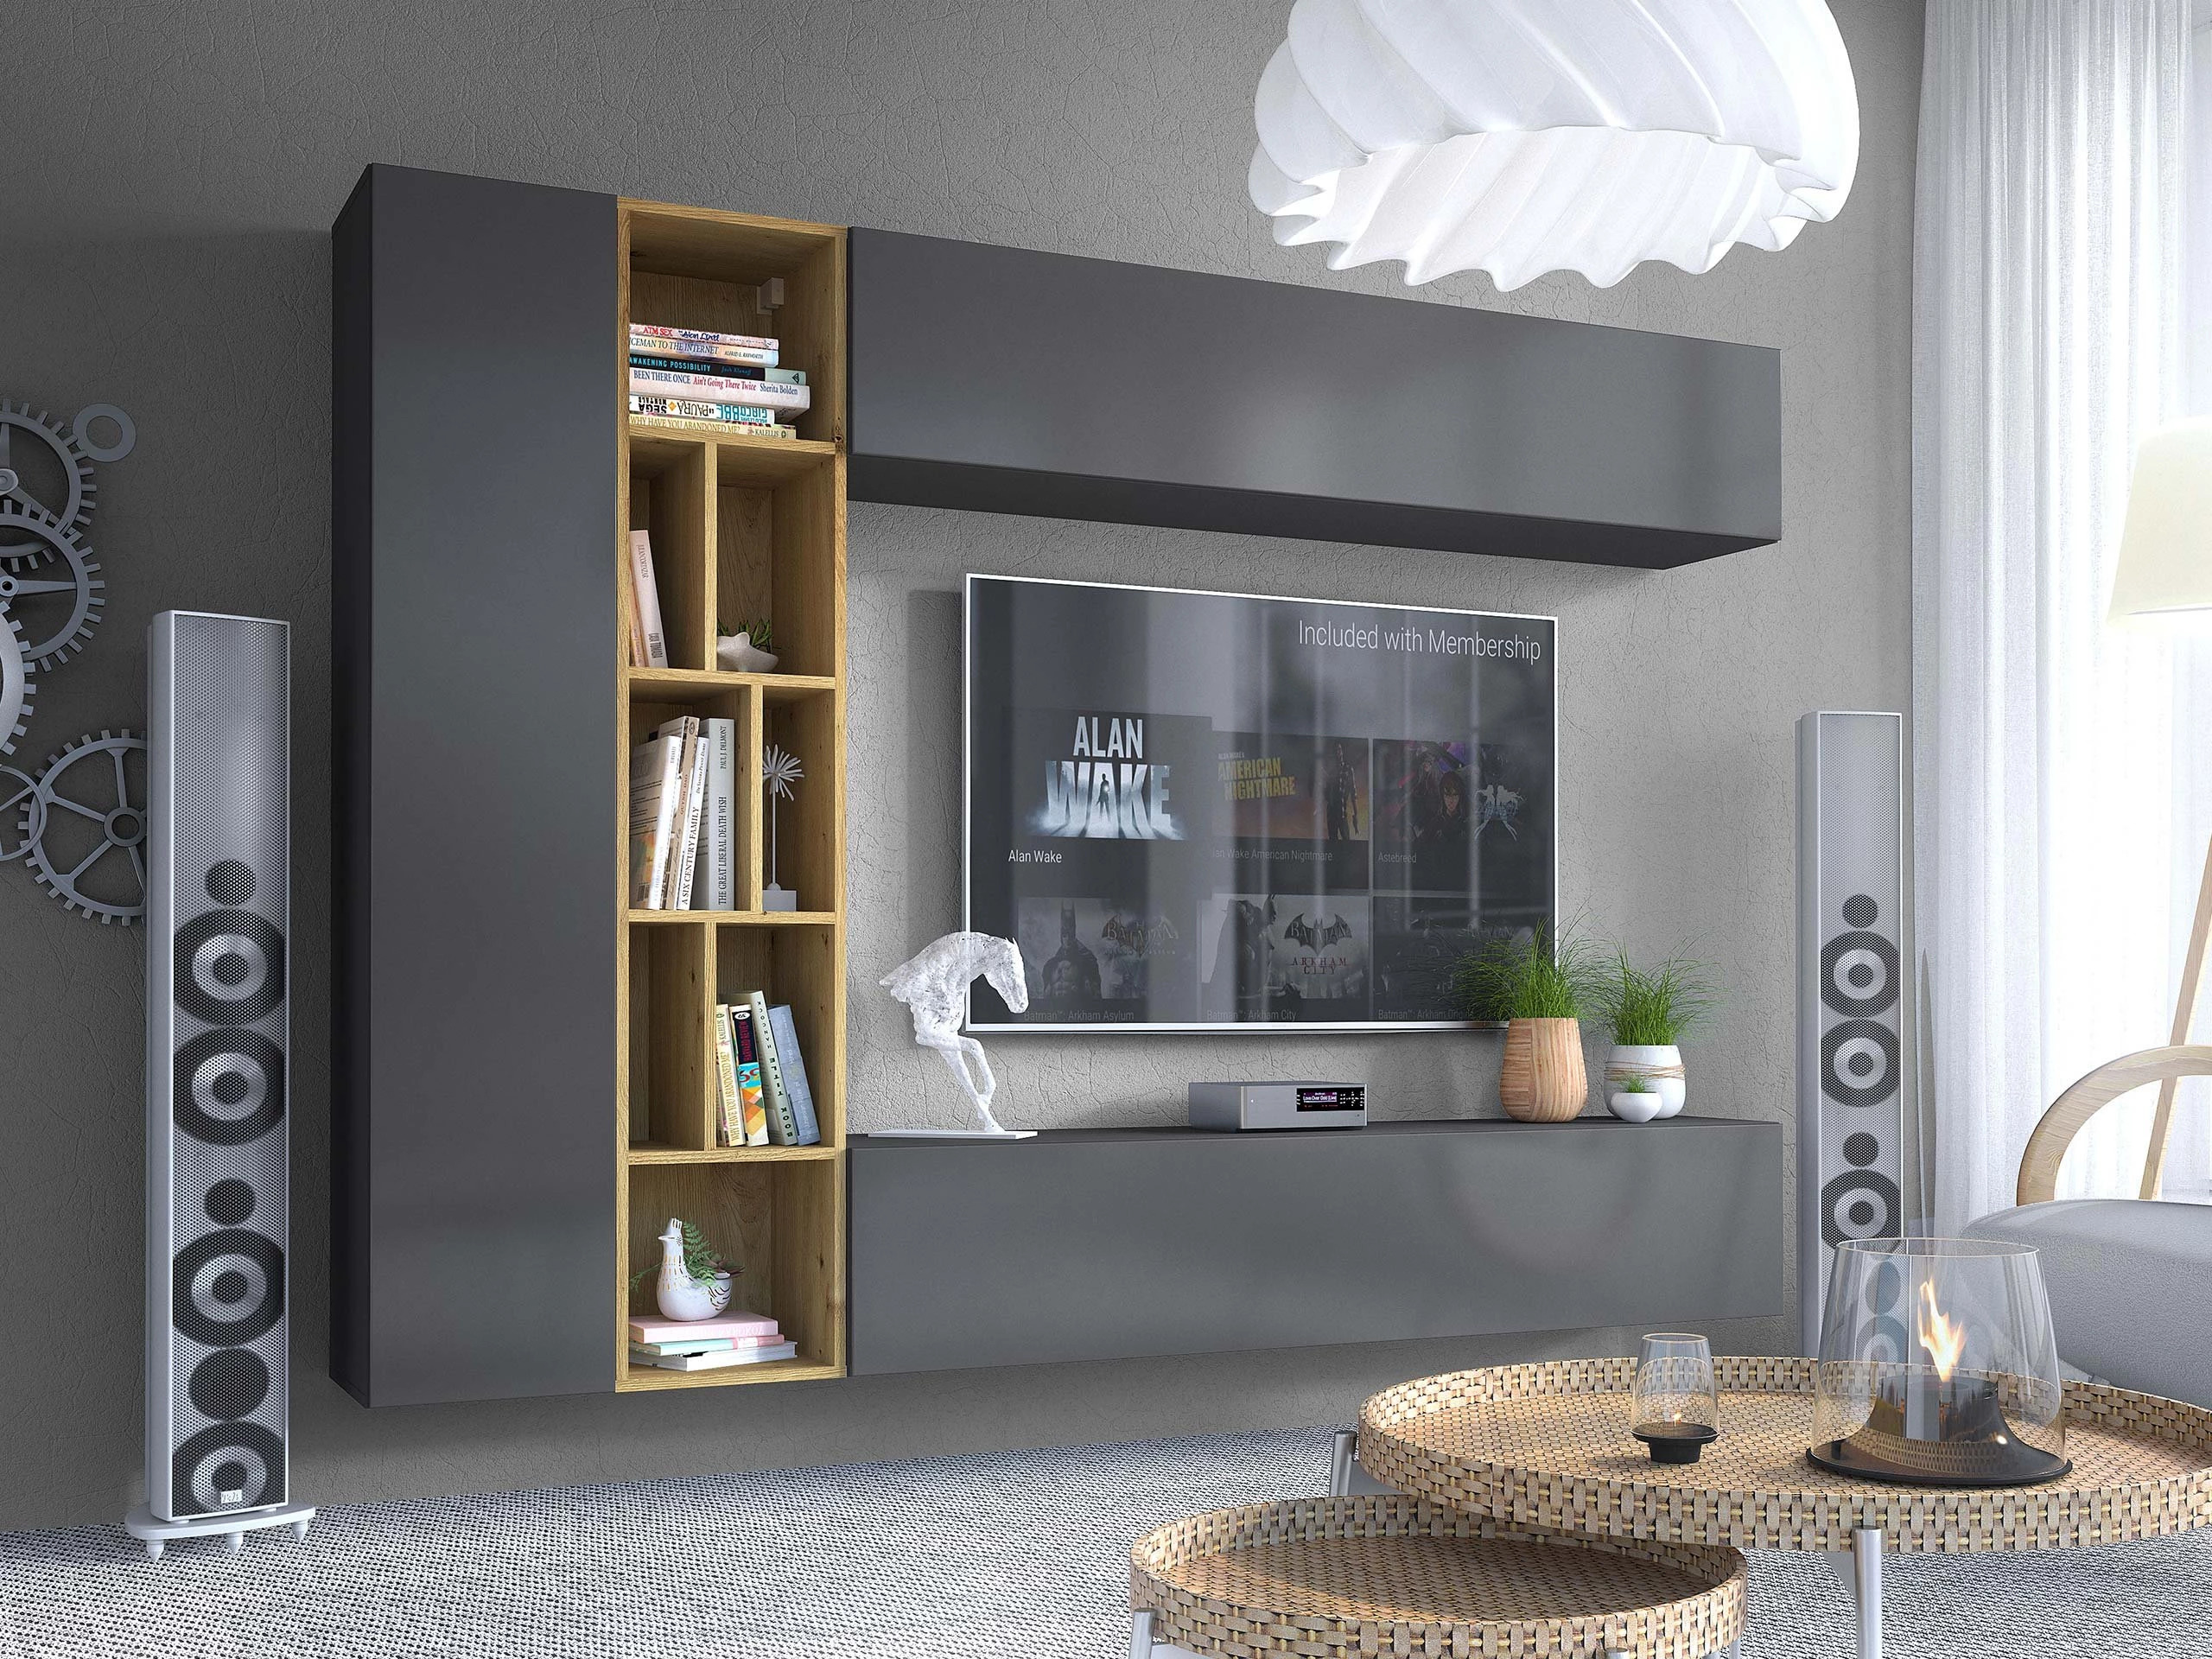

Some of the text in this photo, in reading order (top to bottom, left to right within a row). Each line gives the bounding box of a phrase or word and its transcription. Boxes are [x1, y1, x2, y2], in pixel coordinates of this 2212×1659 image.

[658, 340, 668, 349] TO
[669, 341, 683, 351] THE
[683, 342, 720, 355] INTERNET
[629, 357, 711, 372] AWAKENING POSSIBILITY
[633, 370, 798, 395] BEEN THERE ONCE Ain't Going There Twice Sherita Bolden
[639, 403, 667, 414] SEGA
[630, 415, 741, 435] WHY HAVE YOU ABANDONED ME?
[1299, 620, 1541, 665] Included with Membership
[1072, 715, 1143, 760] ALAN
[1217, 757, 1281, 781] AMERICAN
[1224, 776, 1296, 801] NIGHTMARE
[1039, 760, 1180, 838] WAKE
[689, 806, 700, 839] FAMILY
[683, 840, 696, 882] CENTURY
[718, 797, 727, 906] THE GREAT LIBERAL DEATH WISH
[1007, 849, 1063, 863] Alan Wake
[1226, 849, 1249, 860] Wake
[1251, 849, 1290, 861] American
[1291, 849, 1333, 863] Nightmare
[1377, 852, 1417, 863] Astebreed
[682, 883, 690, 898] SIX
[1292, 957, 1347, 967] ARKHAM
[1302, 965, 1336, 976] CITY
[1068, 1010, 1101, 1020] Arkham
[1103, 1009, 1135, 1023] Asylum
[1248, 1009, 1279, 1020] Arkham
[1281, 1008, 1297, 1022] City
[1417, 1008, 1446, 1020] Arkham
[716, 1020, 727, 1040] KALELLIS
[770, 1057, 784, 1096] TITLE
[721, 1052, 741, 1141] WHY HAVE YOU ABANDONED ME?
[780, 1107, 793, 1137] BOOK
